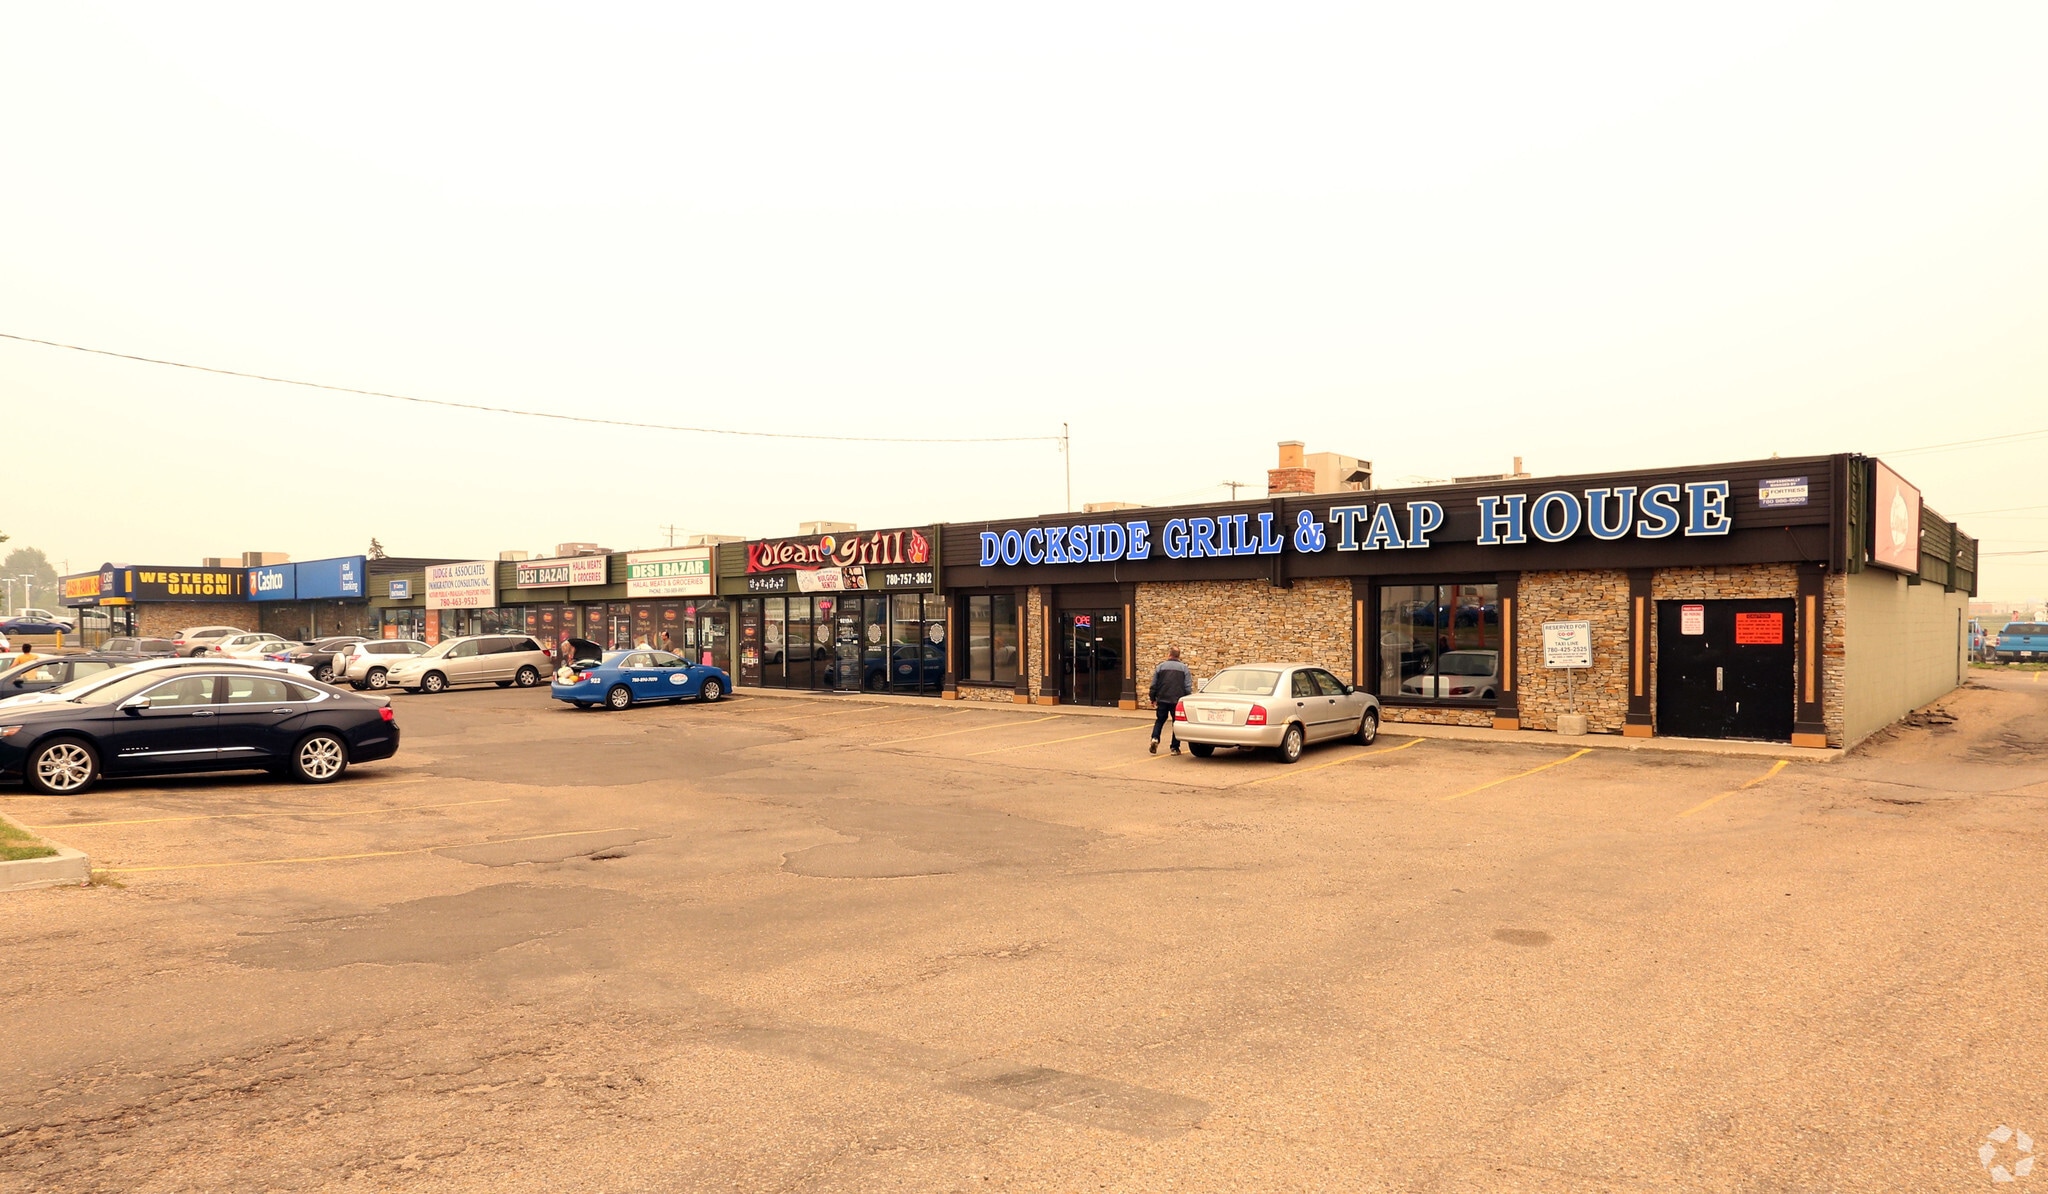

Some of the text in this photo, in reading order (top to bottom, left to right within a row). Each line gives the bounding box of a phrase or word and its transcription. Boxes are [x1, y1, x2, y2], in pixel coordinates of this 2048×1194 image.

[979, 480, 1732, 567] DOCKSIDE GRILL & TAP HOUSE
[745, 531, 906, 574] Korean grill
[572, 560, 602, 571] HALAL MEATS
[632, 560, 704, 578] DESI BAZAR
[139, 572, 227, 584] WESTERN
[433, 567, 448, 581] JUDGE
[455, 564, 485, 577] ASSOCIATES
[519, 567, 569, 584] DESI BAZAR
[577, 572, 602, 582] GROCERIES
[258, 569, 283, 591] Cashco
[455, 578, 480, 588] CONSULTING
[633, 580, 649, 588] HALAL
[650, 579, 667, 587] MEATS
[673, 577, 704, 586] GROCERIES
[168, 583, 227, 595] UNION
[342, 581, 358, 592] banking
[440, 597, 478, 607] 780-463-9523
[1075, 615, 1090, 624] OPE
